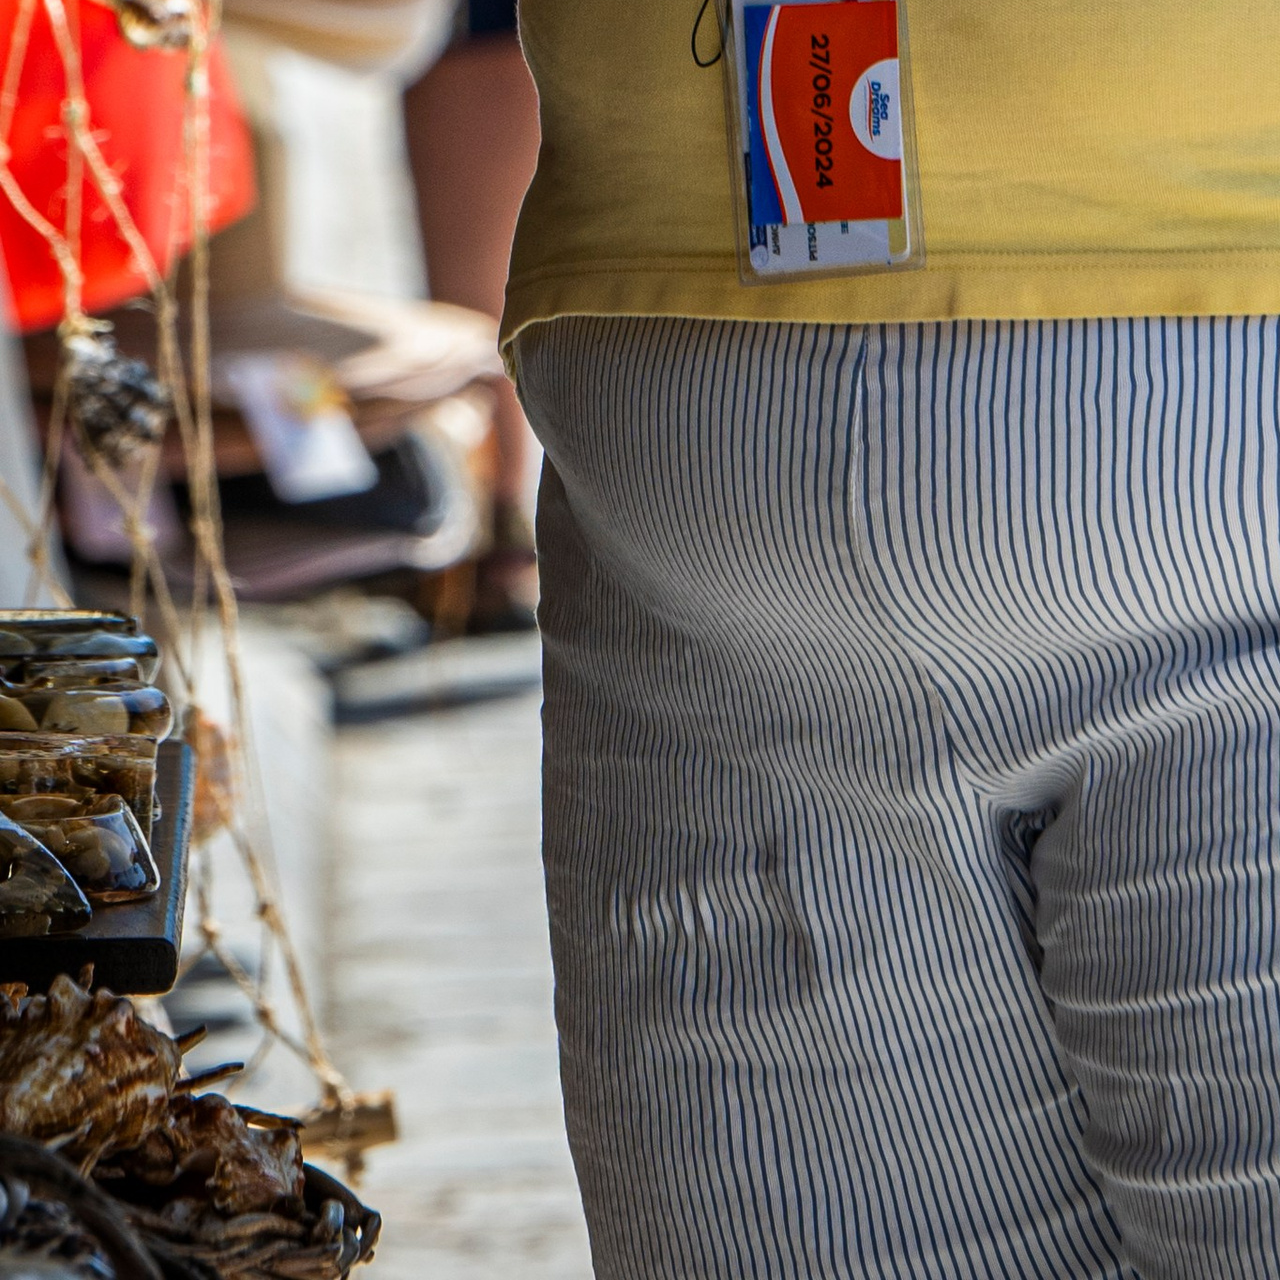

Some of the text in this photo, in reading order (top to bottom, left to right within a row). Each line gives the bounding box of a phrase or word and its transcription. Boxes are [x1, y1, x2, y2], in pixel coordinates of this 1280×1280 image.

[810, 34, 833, 189] 27/06/2024
[871, 81, 881, 136] Dreams
[880, 93, 890, 121] Sea
